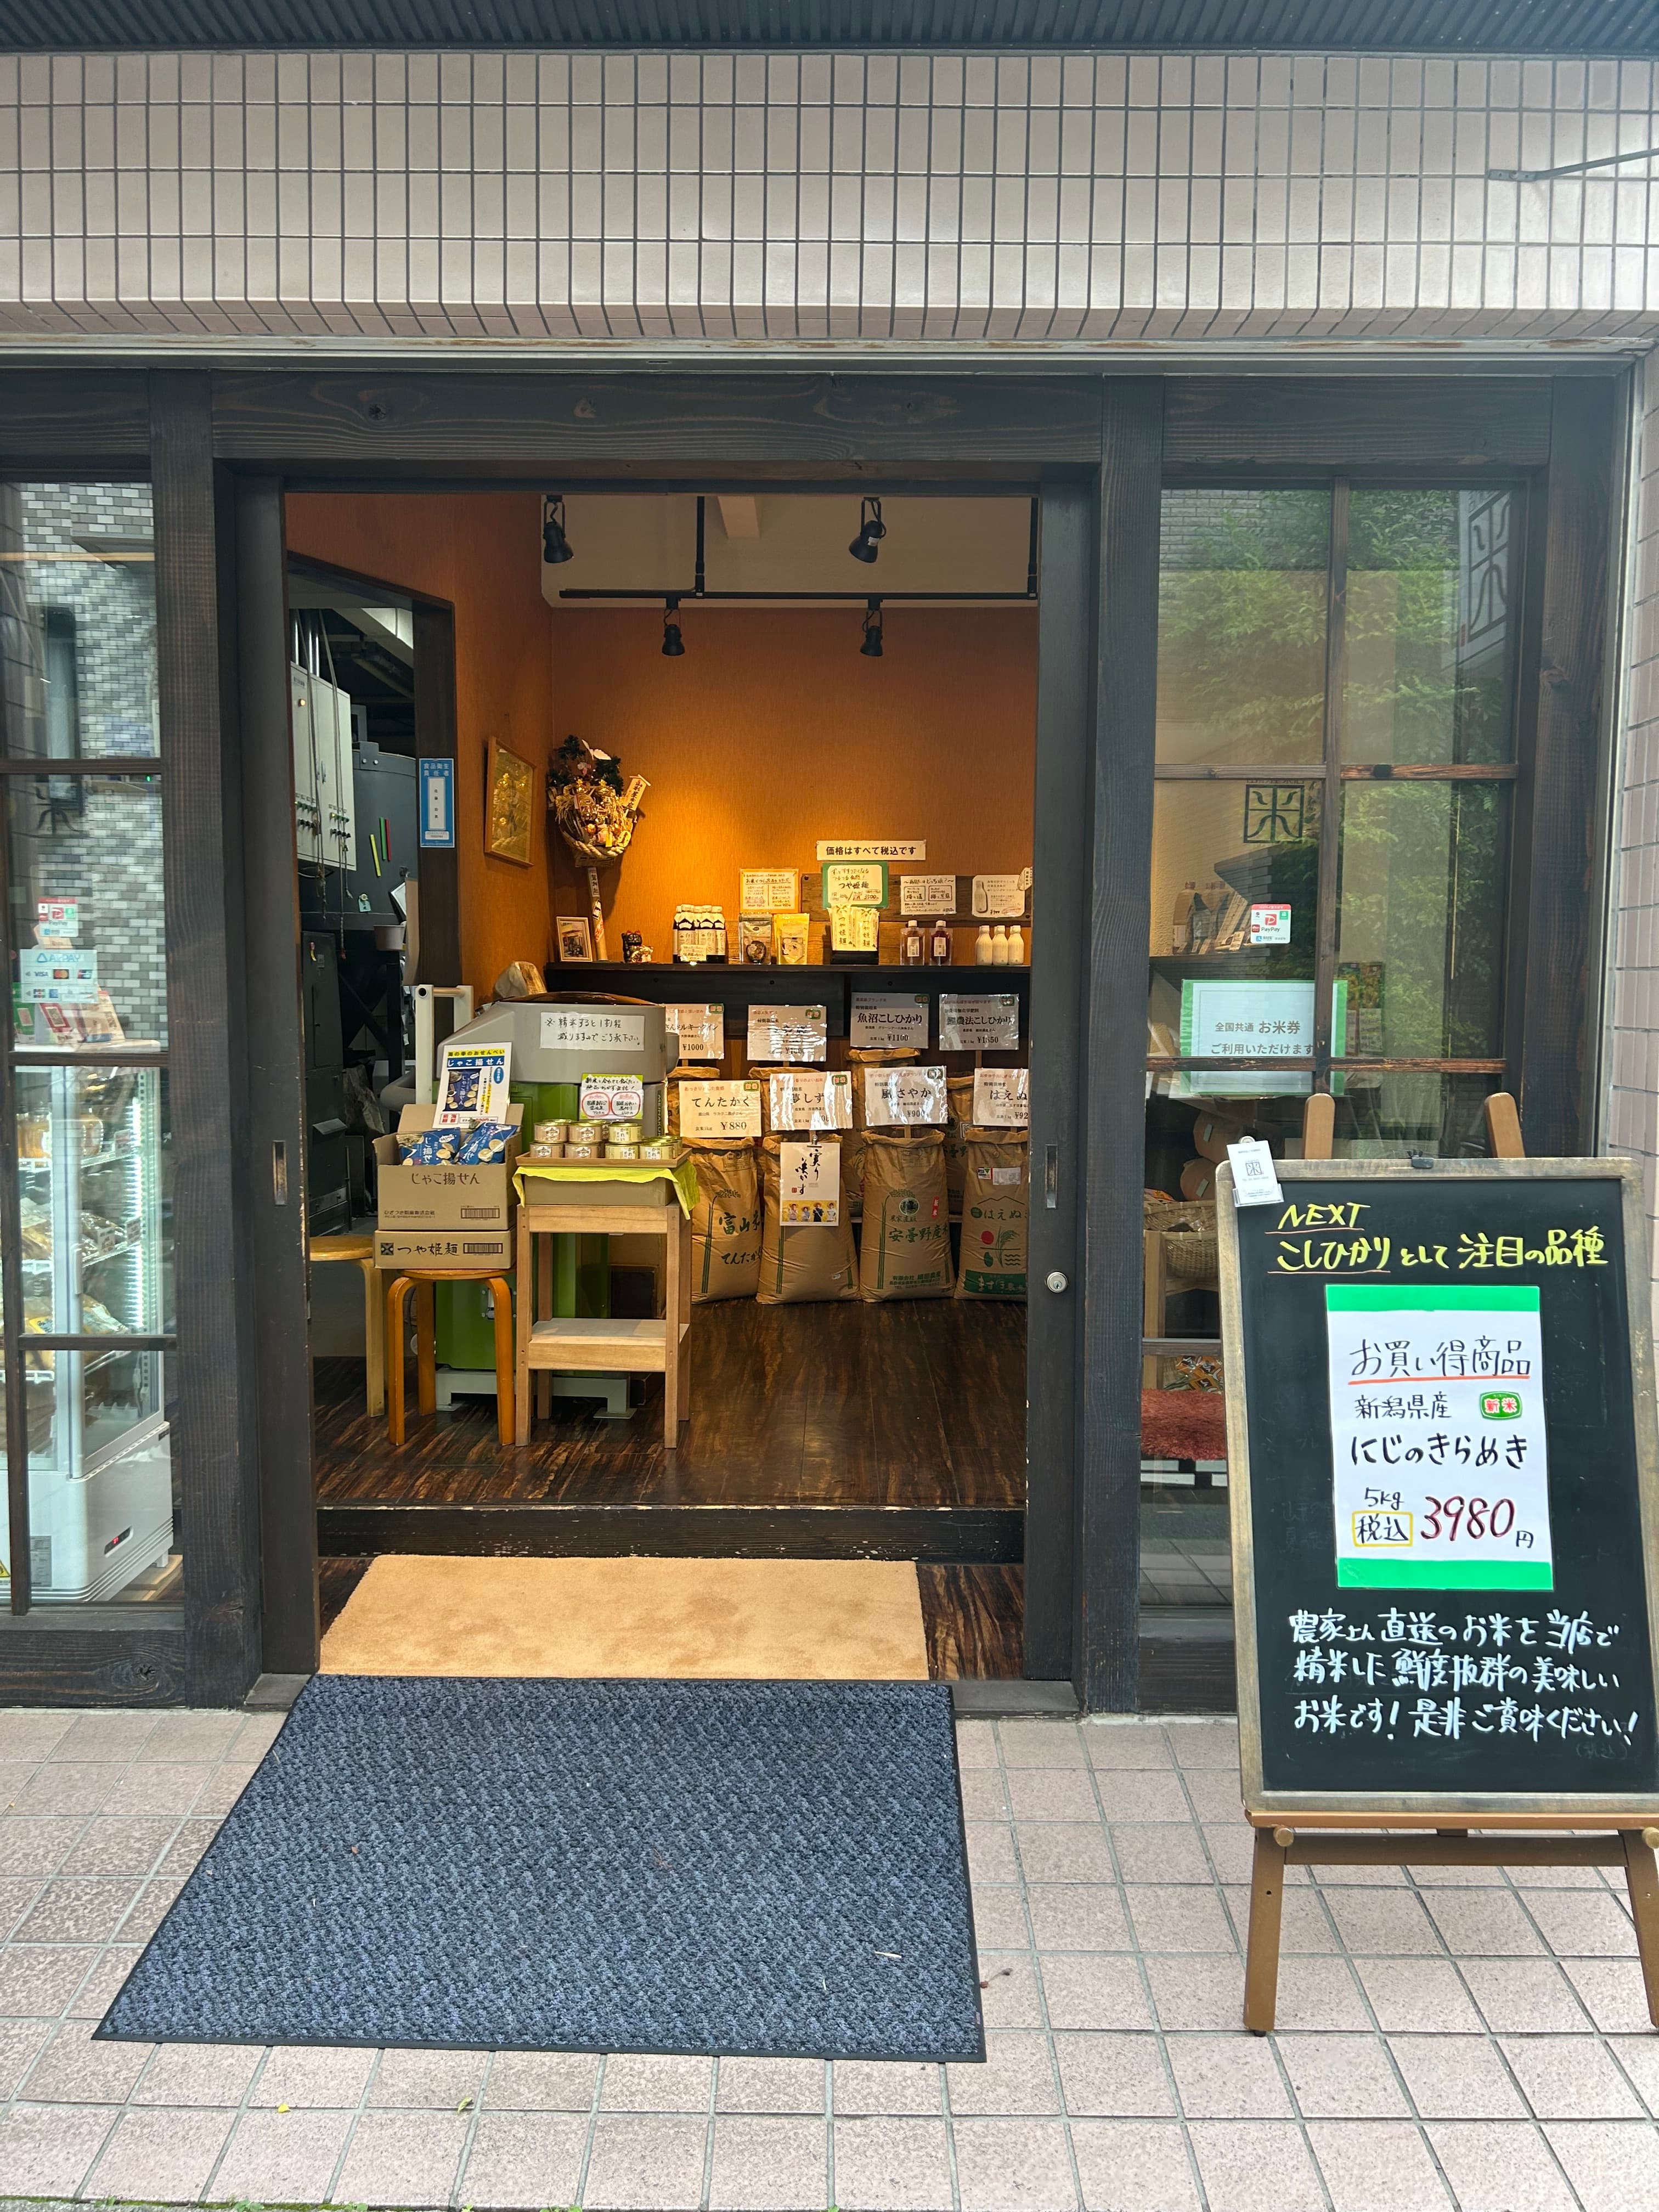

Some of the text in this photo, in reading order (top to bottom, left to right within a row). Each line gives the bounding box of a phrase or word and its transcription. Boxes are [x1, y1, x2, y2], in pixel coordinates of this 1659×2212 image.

[826, 846, 916, 855] 価格はすべて税込です
[857, 1012, 922, 1024] 魚沼こしひかり
[1215, 1020, 1301, 1035] 全国共通 お米券
[1211, 1043, 1313, 1054] ご利用いただけます
[448, 1058, 504, 1066] じゃこ揚せん
[792, 1092, 827, 1104] 夢しず
[882, 1088, 932, 1099] 風さやか
[691, 1097, 749, 1108] てんたかく
[720, 1121, 747, 1130] ¥880
[411, 1172, 481, 1185] じゃこ揚せん
[984, 1209, 1028, 1221] はえぬ
[1278, 1203, 1371, 1230] NEXT
[888, 1223, 949, 1243] 安曇野産米
[397, 1242, 460, 1256] つや姫麺
[1348, 1335, 1531, 1378] お買い得商品
[1353, 1391, 1453, 1420] 新潟県産
[1483, 1397, 1518, 1414] 新米
[1351, 1435, 1529, 1469] にじのきらめき
[1364, 1488, 1405, 1511] 5kg
[1354, 1513, 1410, 1544] 税込
